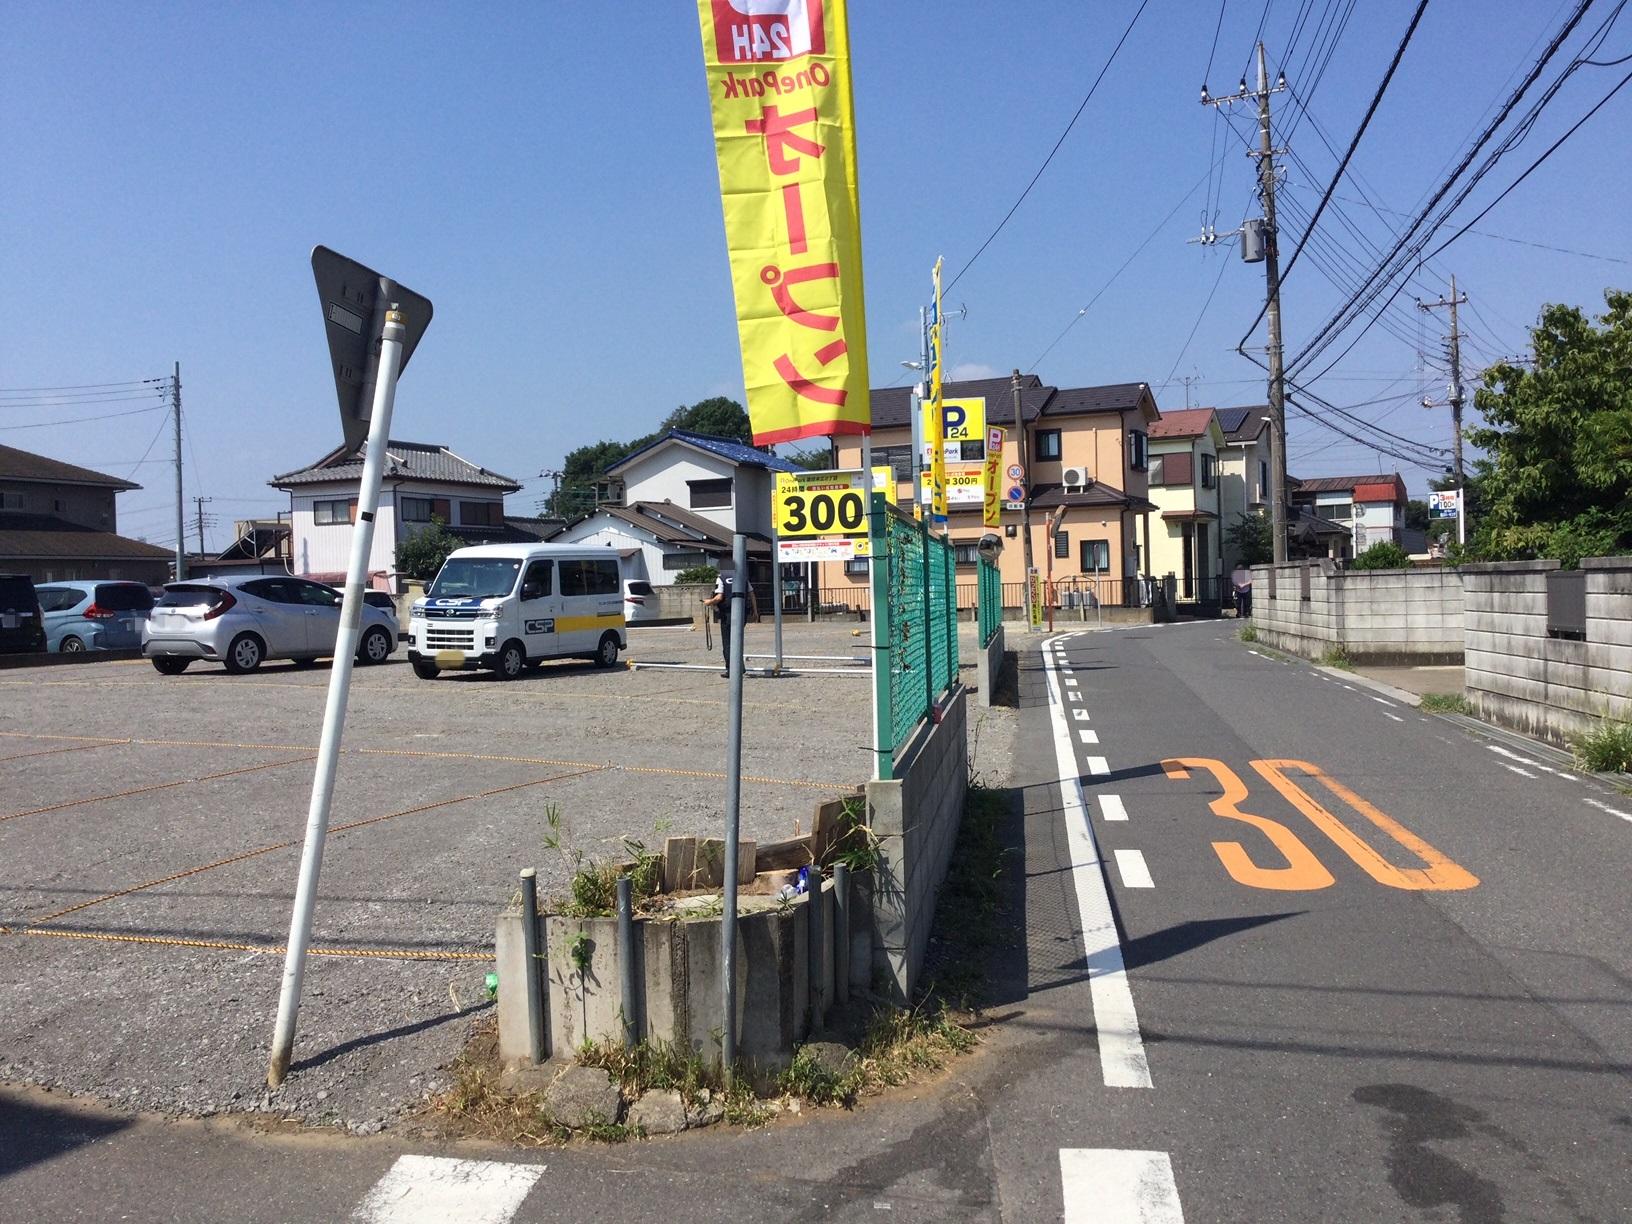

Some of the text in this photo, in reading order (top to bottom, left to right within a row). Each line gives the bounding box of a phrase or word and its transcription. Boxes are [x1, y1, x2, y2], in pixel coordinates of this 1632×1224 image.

[942, 406, 966, 439] P
[951, 427, 969, 439] 24
[1010, 468, 1020, 477] 30
[952, 477, 978, 486] 300円
[986, 460, 999, 522] オープン
[783, 492, 864, 532] 300
[435, 598, 473, 606] CSP
[525, 620, 555, 634] CSP
[1160, 757, 1481, 891] 30
